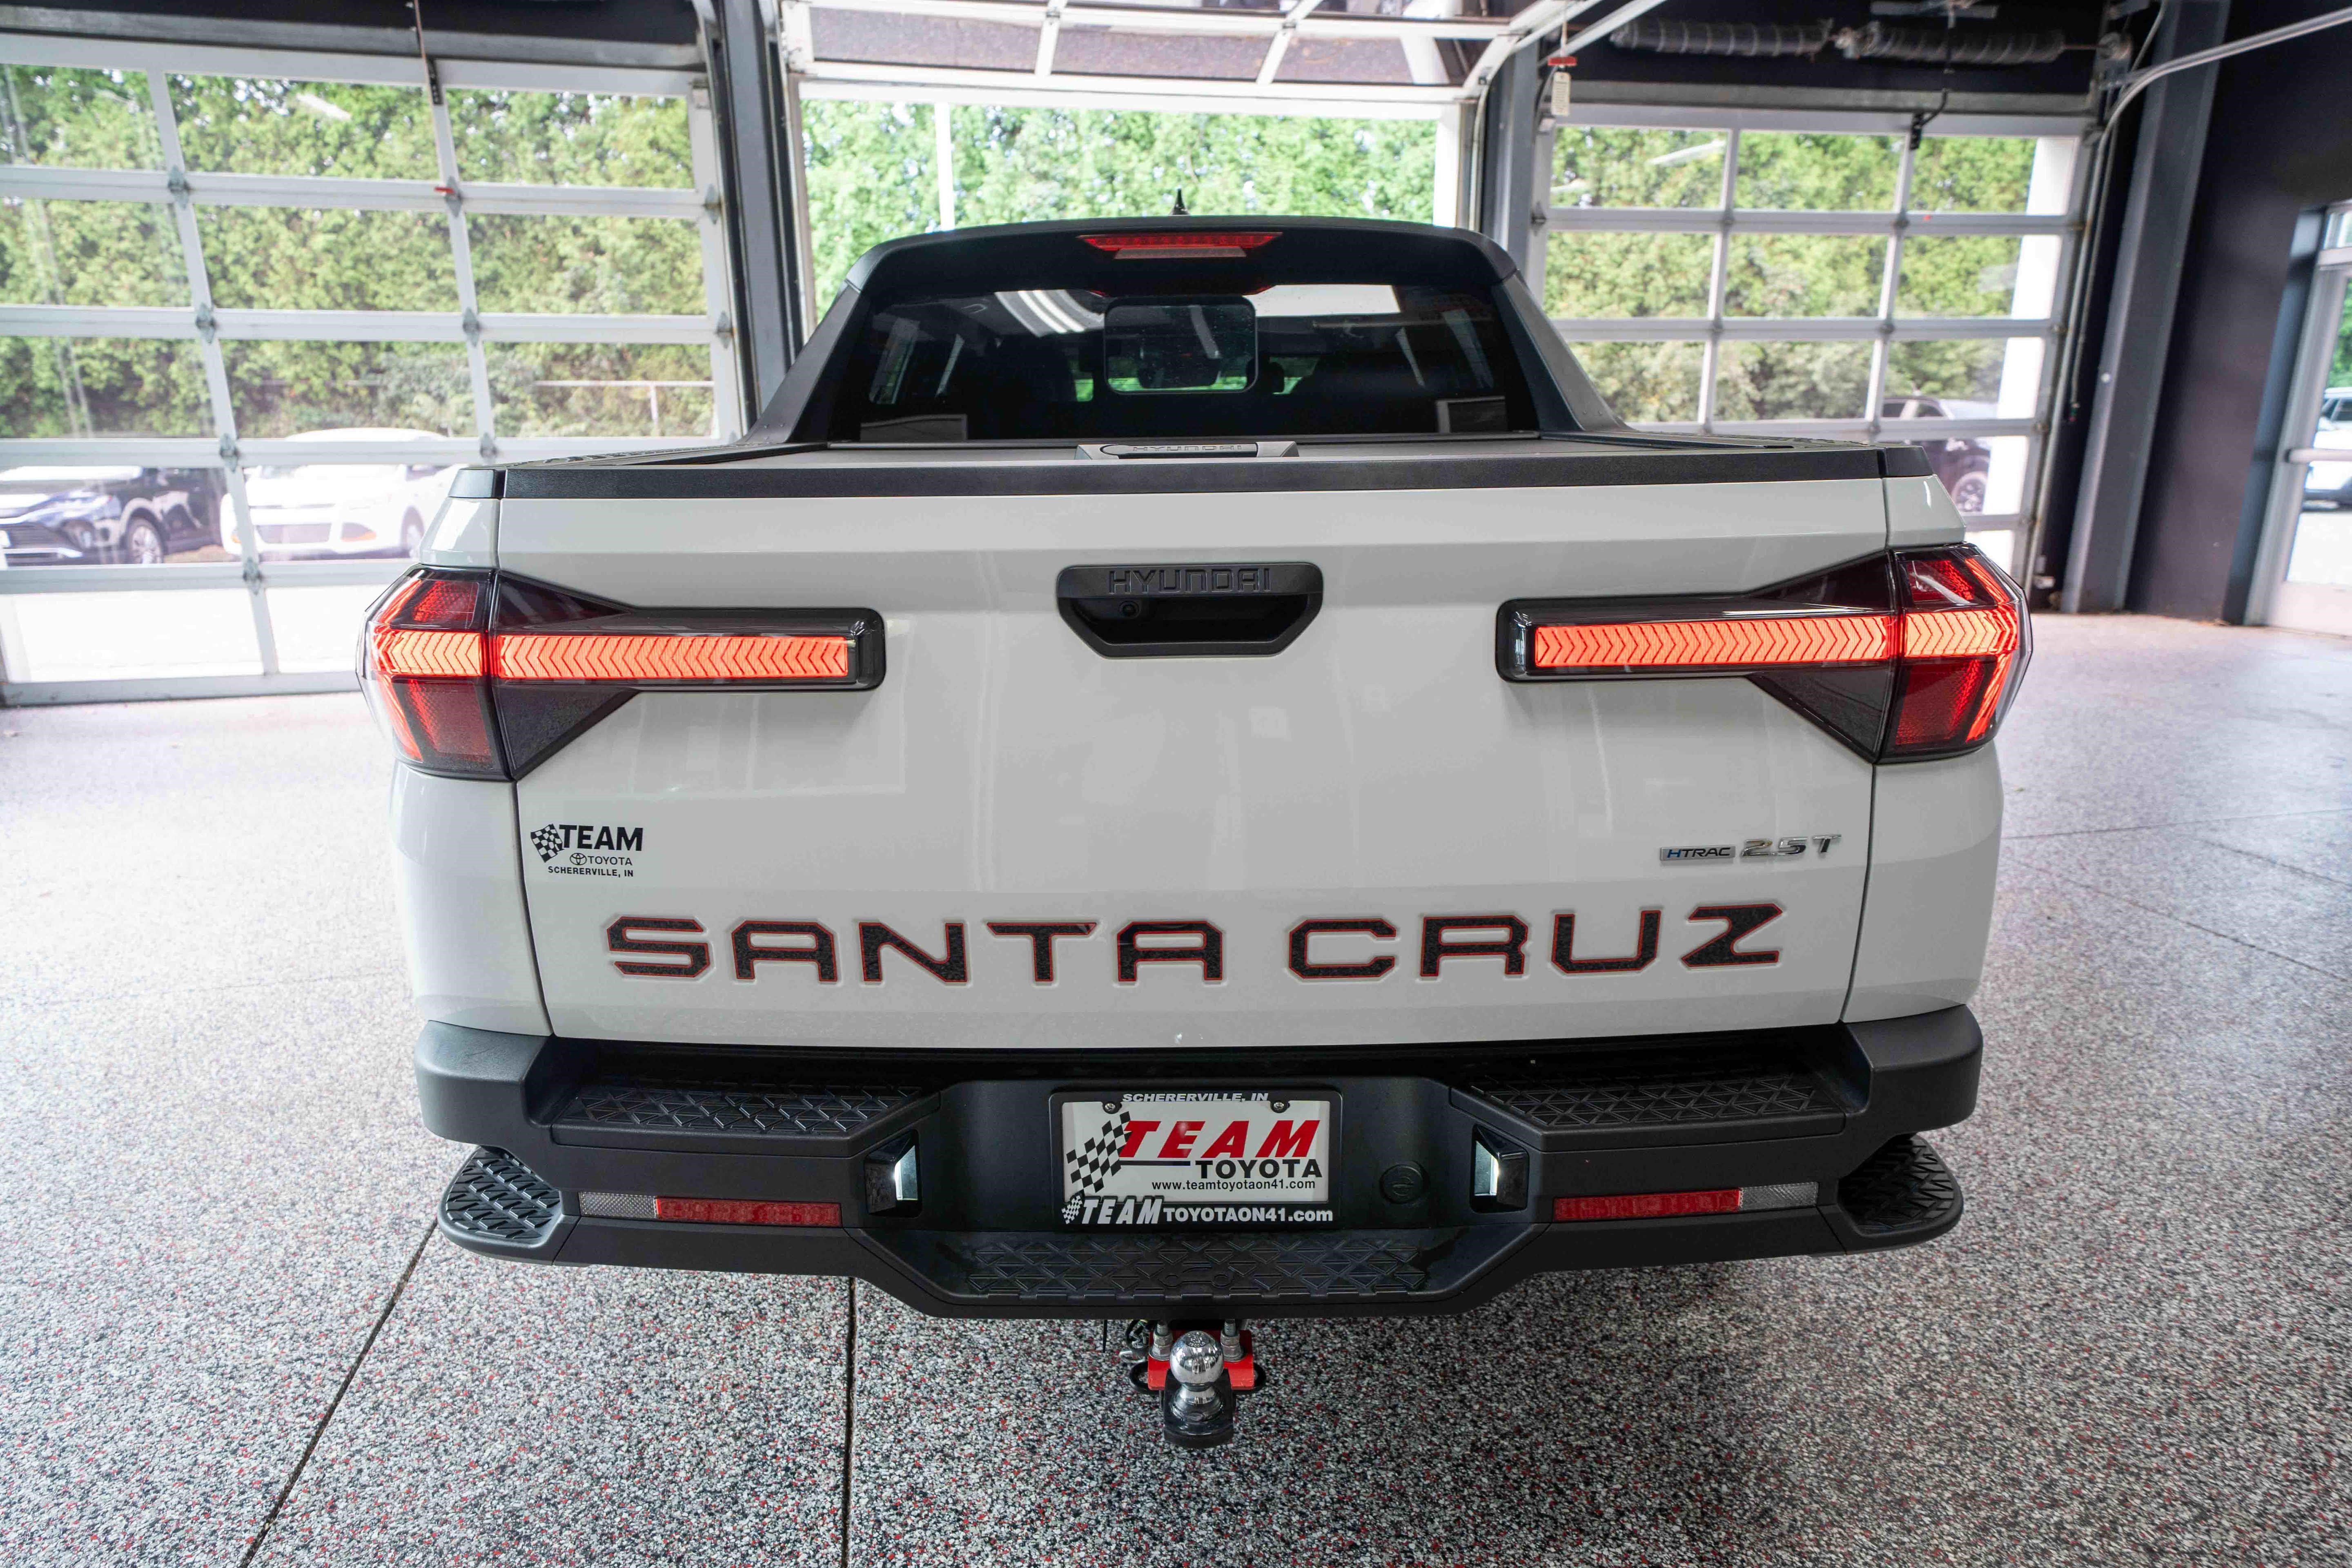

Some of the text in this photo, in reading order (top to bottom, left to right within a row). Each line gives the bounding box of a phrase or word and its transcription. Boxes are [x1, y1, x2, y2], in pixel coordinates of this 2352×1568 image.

[1108, 568, 1271, 594] HYUNDAI
[559, 824, 643, 851] TEAM
[588, 855, 633, 865] TOYOTA
[1667, 847, 1731, 858] HTRAC
[548, 866, 621, 878] SCHERERVILLE,
[607, 903, 1782, 985] SANTA CRUZ
[1122, 1093, 1269, 1102] SCHERERVILLE, IN
[1119, 1120, 1321, 1158] TEAM
[1195, 1159, 1323, 1179] TOYOTA
[1152, 1179, 1316, 1191] www.teamtoyotaon41.com
